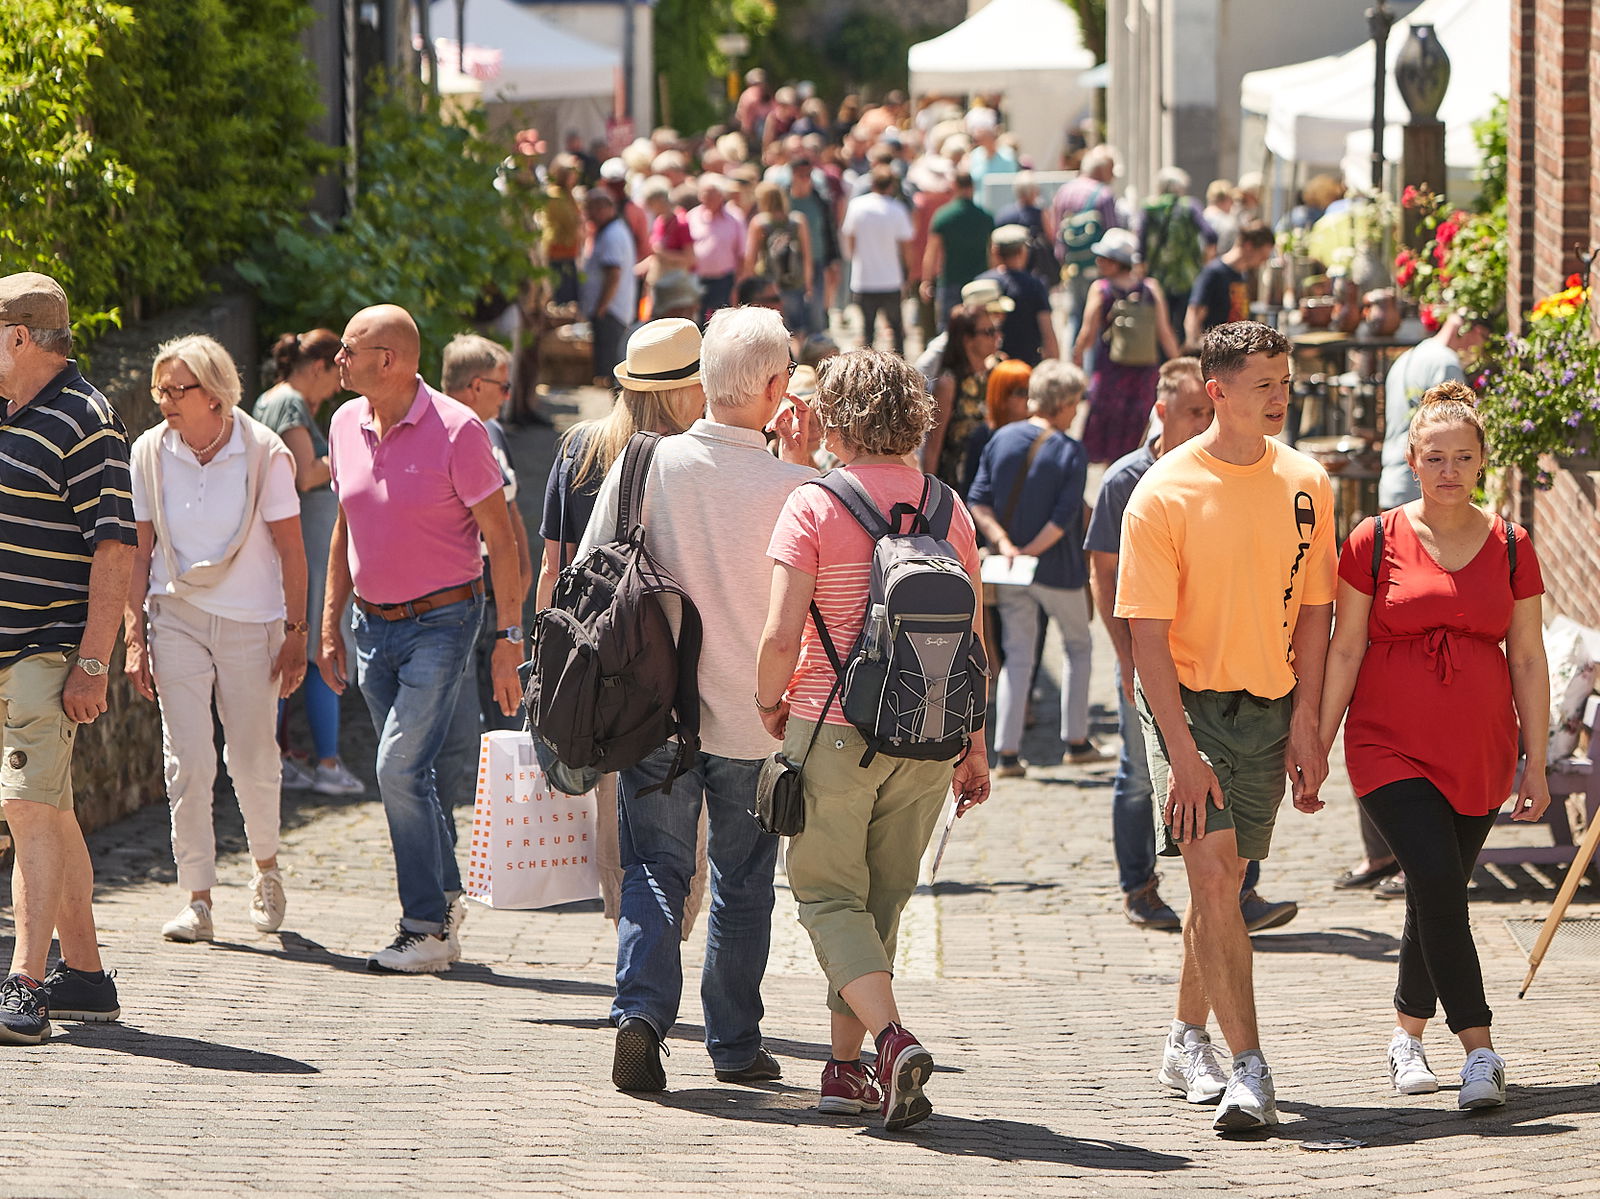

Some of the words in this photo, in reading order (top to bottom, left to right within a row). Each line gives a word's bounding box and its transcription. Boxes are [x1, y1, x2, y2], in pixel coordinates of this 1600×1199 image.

[505, 811, 588, 826] HEISST
[506, 834, 588, 848] FREUDE
[506, 856, 588, 870] SCHENKEN
